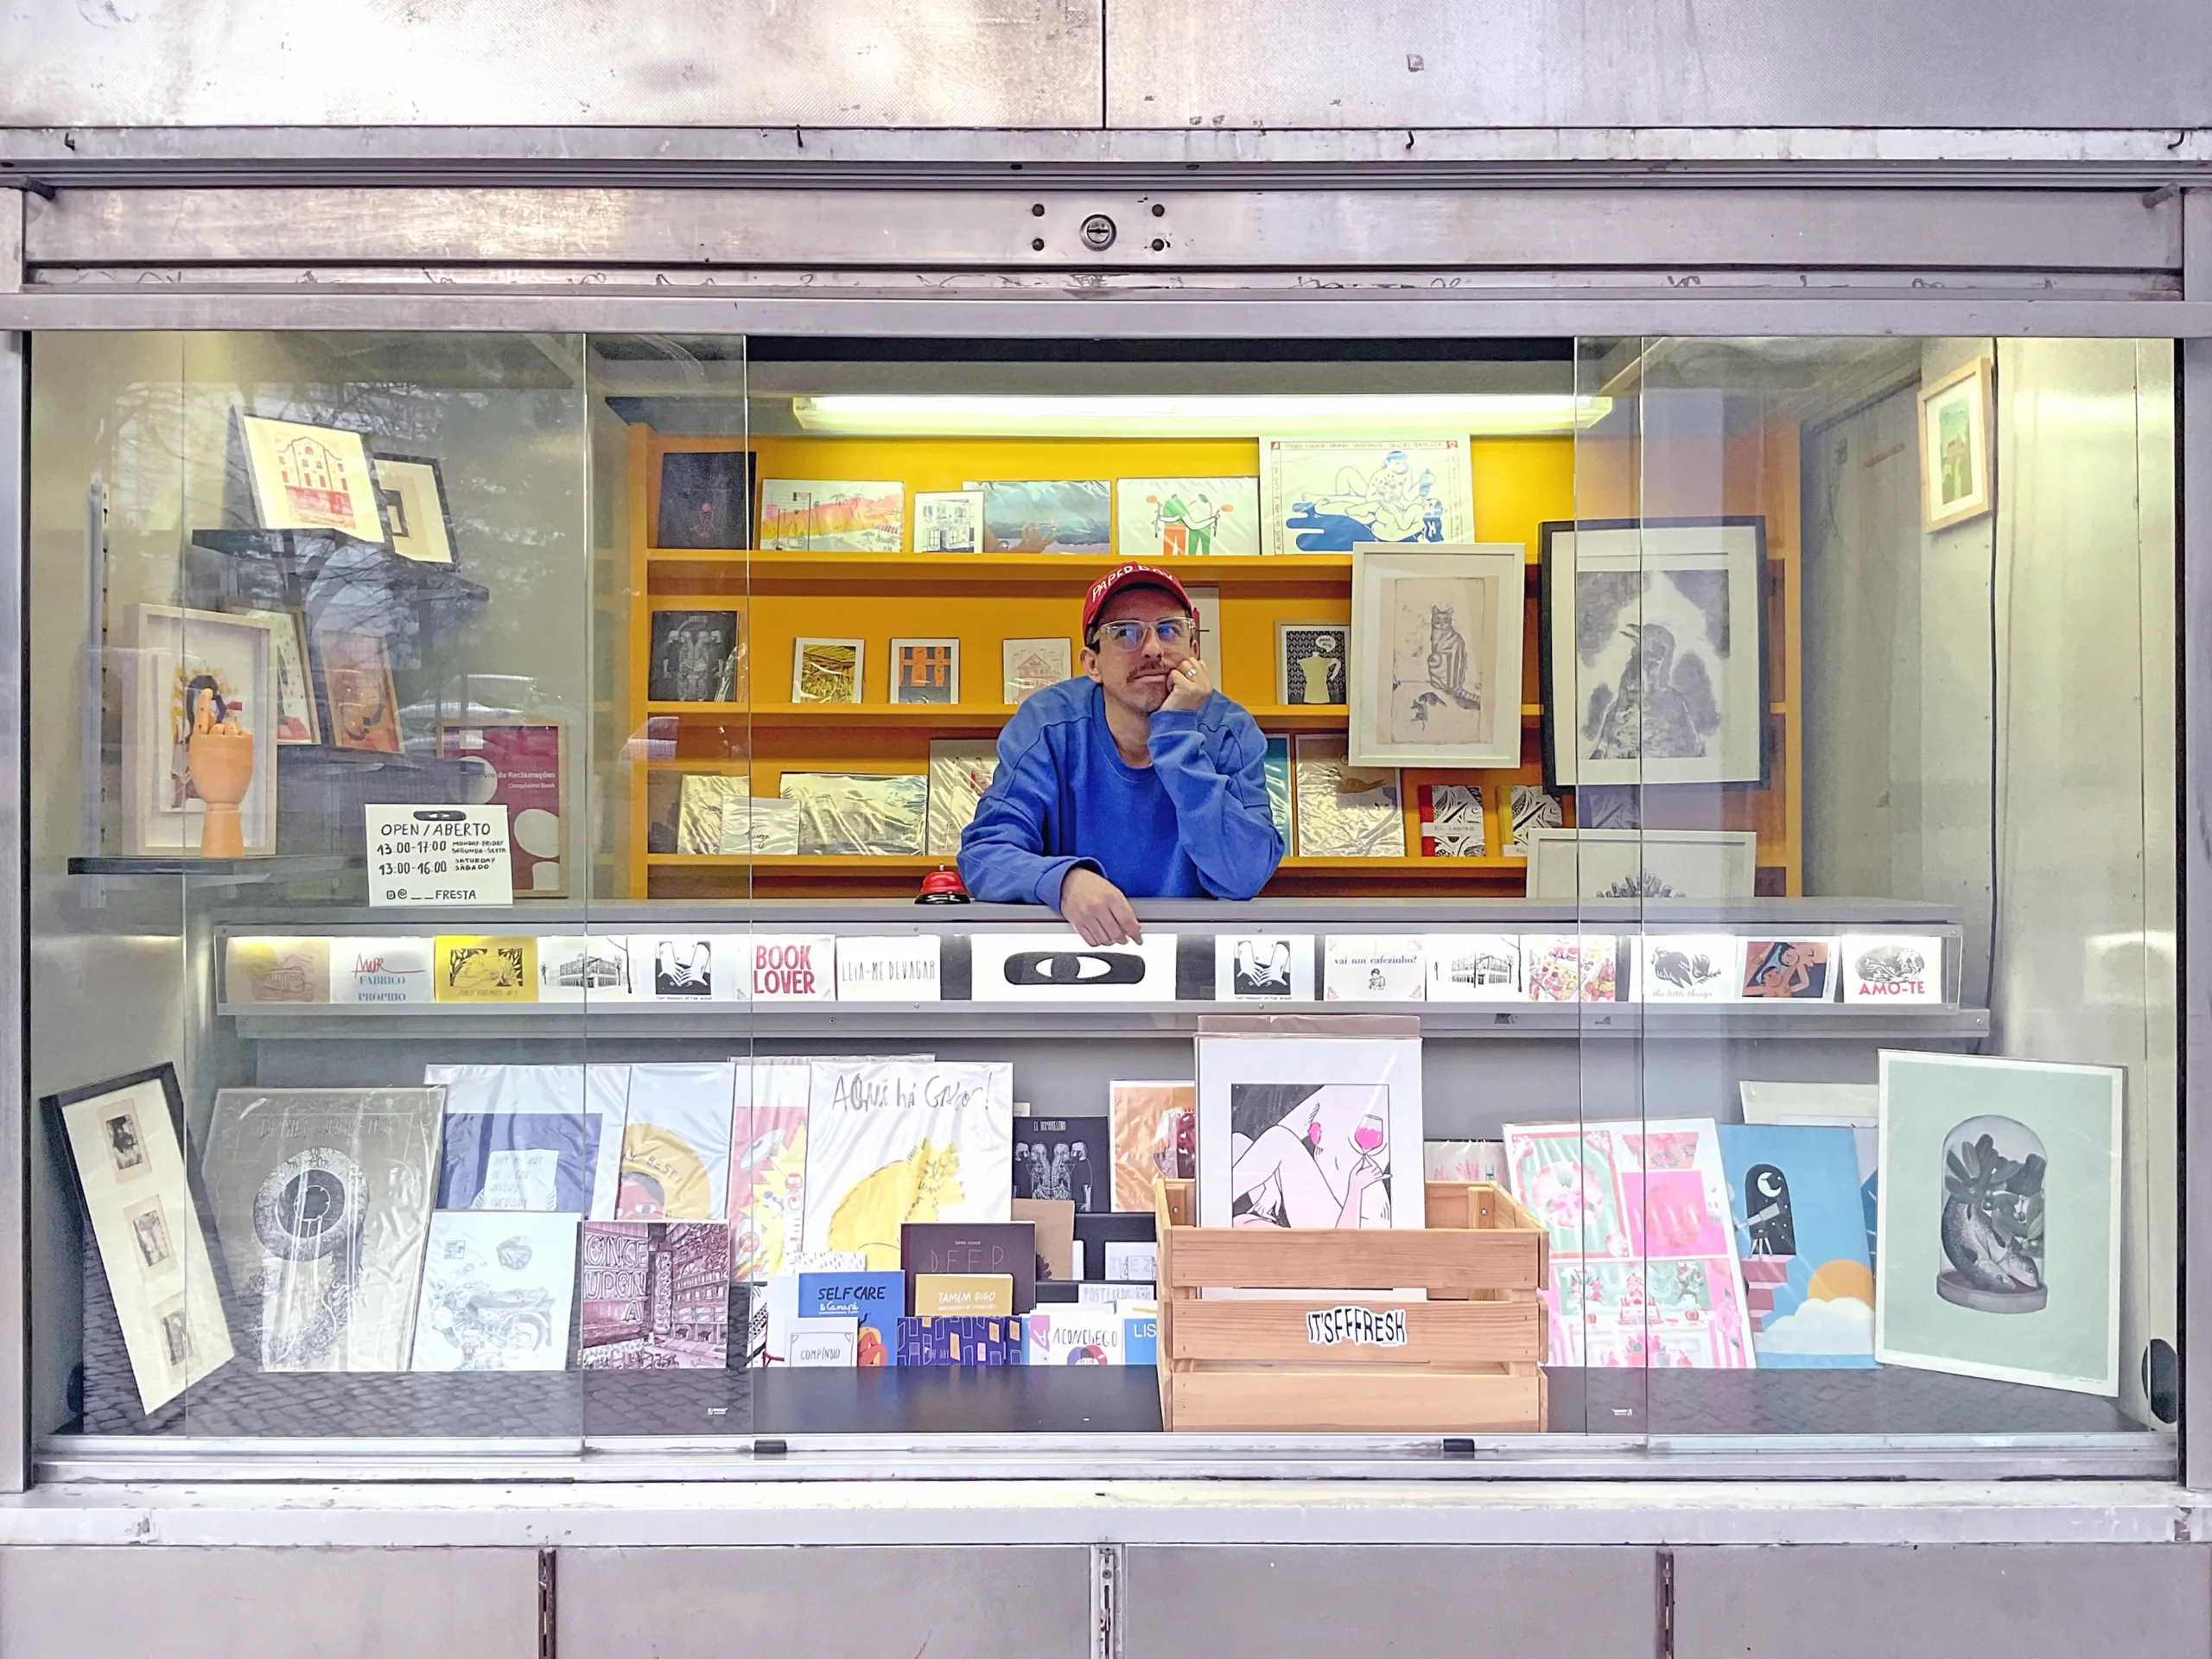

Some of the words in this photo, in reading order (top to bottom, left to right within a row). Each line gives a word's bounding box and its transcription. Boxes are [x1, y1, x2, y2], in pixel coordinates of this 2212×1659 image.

[381, 823, 419, 836] OPEN
[433, 823, 490, 836] ABERTO
[377, 841, 447, 855] 13:00-17:00
[378, 861, 448, 875] 13:00-16:00
[756, 945, 811, 970] BOOK
[1334, 952, 1348, 964] vai
[1370, 951, 1418, 964] cafezinho?
[888, 960, 936, 981] DEVAGAR
[359, 976, 405, 985] FABRICO
[753, 970, 816, 994] LOVER
[1859, 981, 1926, 995] AMO-TE
[587, 1236, 647, 1268] ONCE
[585, 1271, 647, 1299] UPON
[938, 1292, 971, 1304] TAMEM
[975, 1291, 996, 1302] DIGO
[624, 1300, 643, 1322] A
